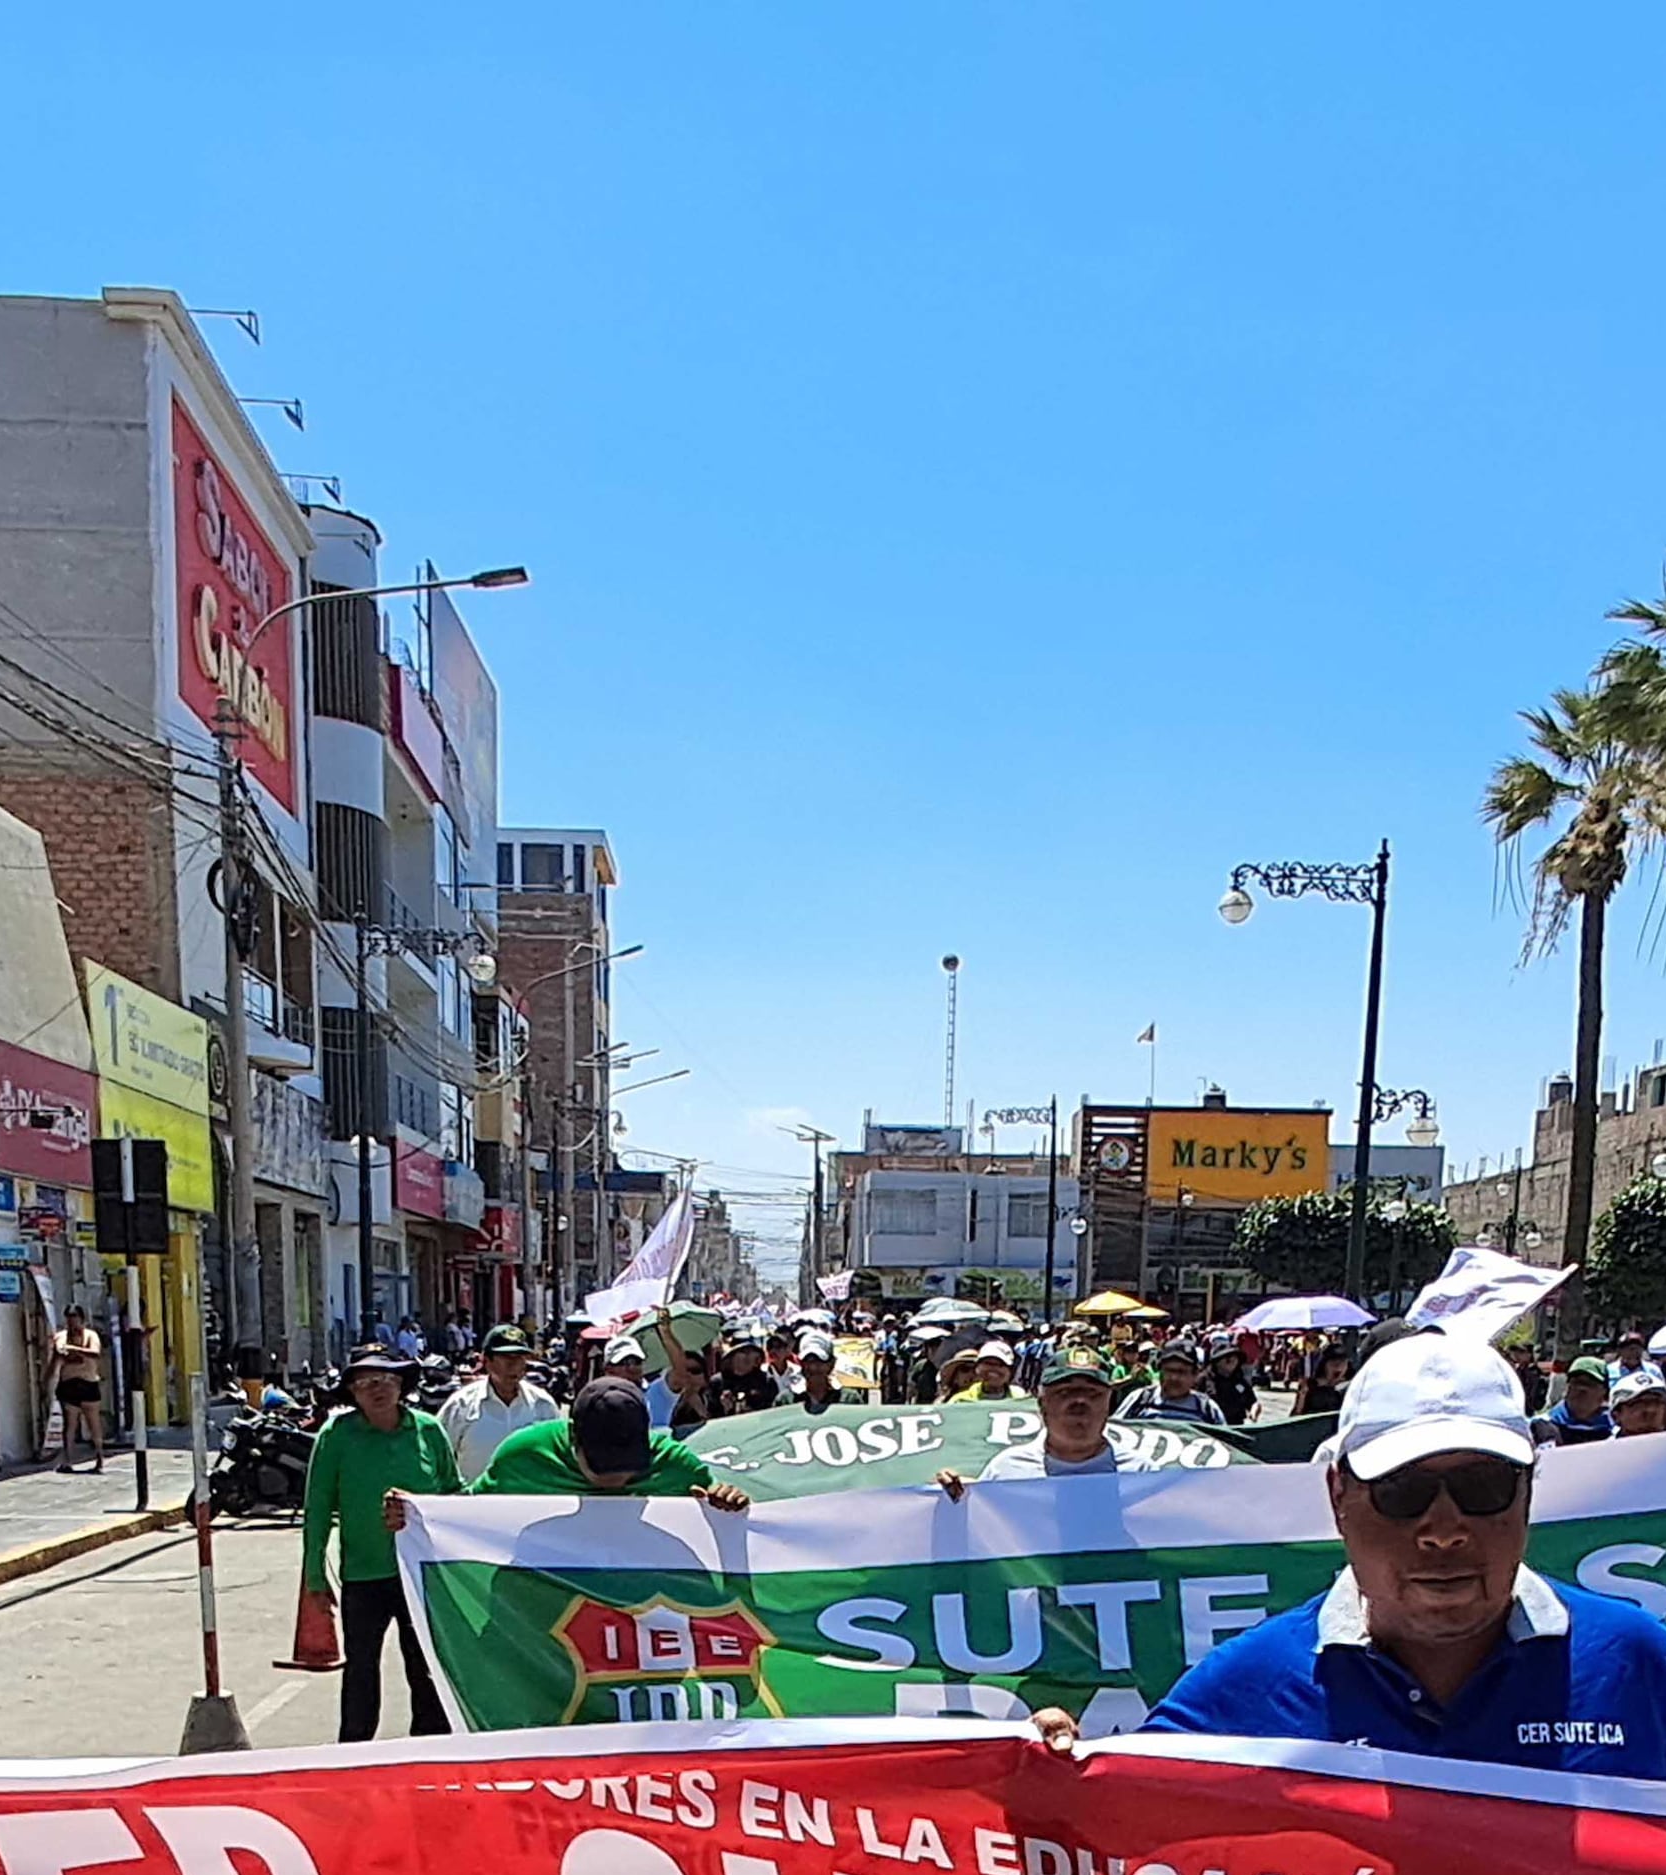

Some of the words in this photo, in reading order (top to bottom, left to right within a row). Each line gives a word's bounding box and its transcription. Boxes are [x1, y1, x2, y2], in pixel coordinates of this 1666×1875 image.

[1170, 1136, 1307, 1174] Marky's
[774, 1409, 946, 1468] JOSÉ
[815, 1573, 1270, 1674] SUTE
[1517, 1723, 1549, 1744] CER
[1554, 1722, 1595, 1744] SUTE
[1598, 1723, 1625, 1746] ICA
[740, 1779, 835, 1847] EN
[856, 1807, 953, 1869] LA
